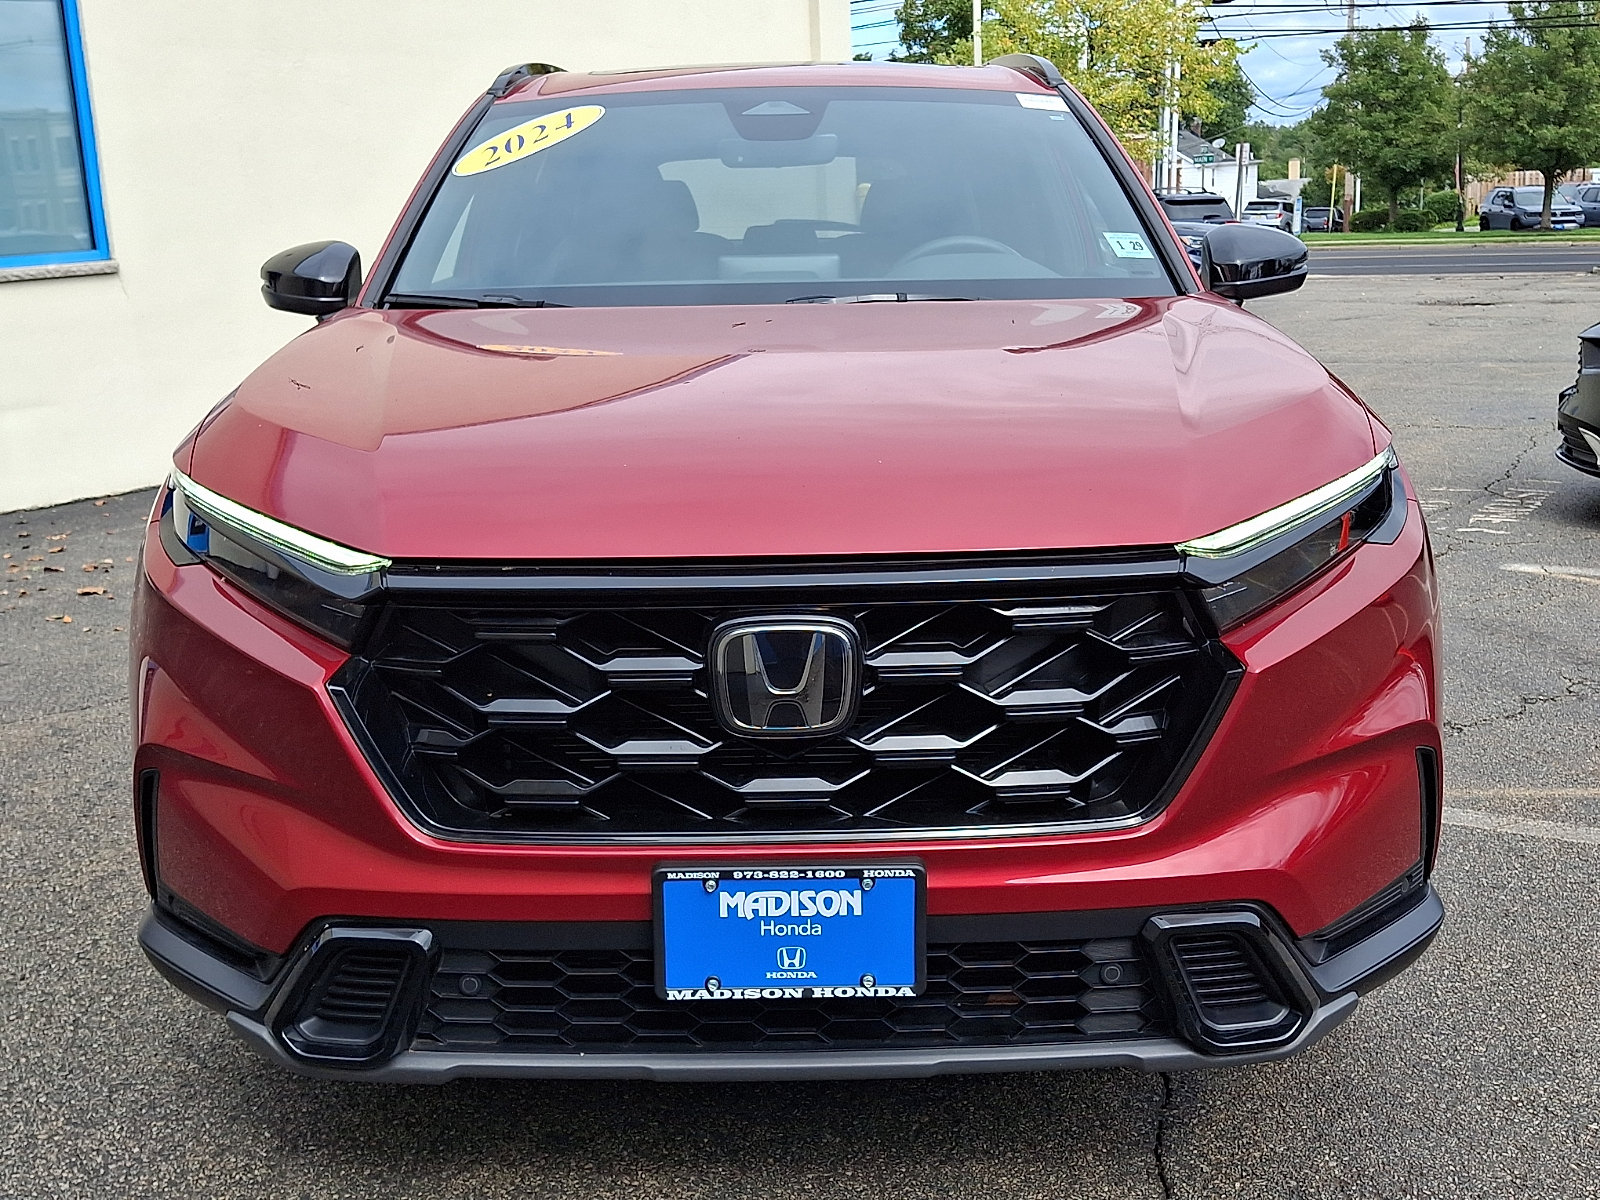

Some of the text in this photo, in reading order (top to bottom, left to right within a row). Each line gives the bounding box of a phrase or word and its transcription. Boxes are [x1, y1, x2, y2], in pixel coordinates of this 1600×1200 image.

[483, 112, 575, 167] 2024
[1129, 241, 1144, 251] 29
[733, 870, 846, 879] 973-822-1600
[863, 869, 916, 878] HONDA
[719, 889, 862, 920] MADISON
[760, 919, 822, 936] Honda
[766, 971, 818, 979] HONDA
[666, 987, 916, 1000] MADISON HONDA
